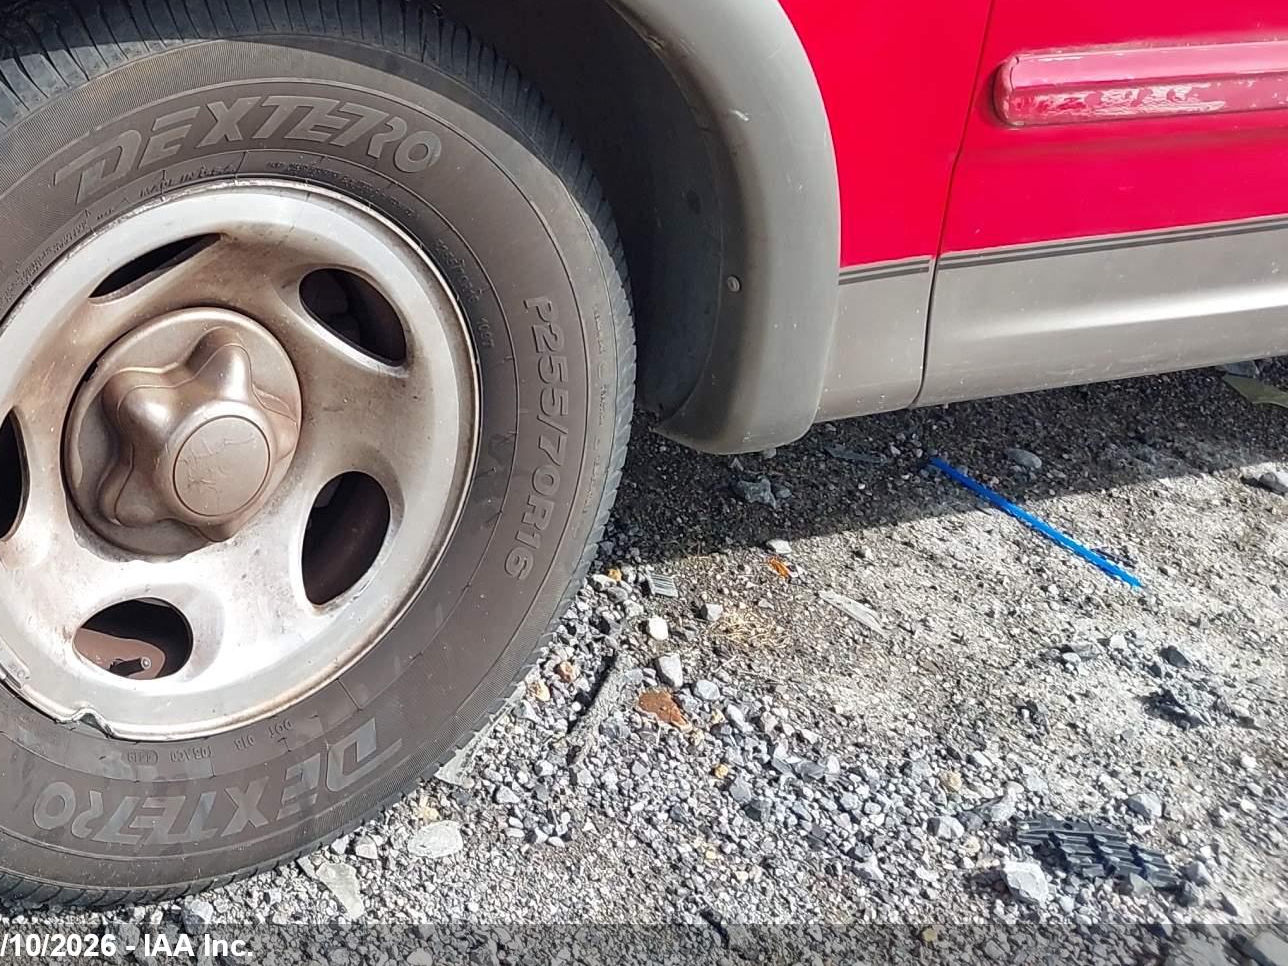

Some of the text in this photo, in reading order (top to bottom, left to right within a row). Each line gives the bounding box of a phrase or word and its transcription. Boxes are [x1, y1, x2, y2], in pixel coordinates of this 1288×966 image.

[52, 94, 443, 205] DEXTERO
[503, 296, 570, 581] P255/70R16
[32, 716, 403, 845] DEXTERO
